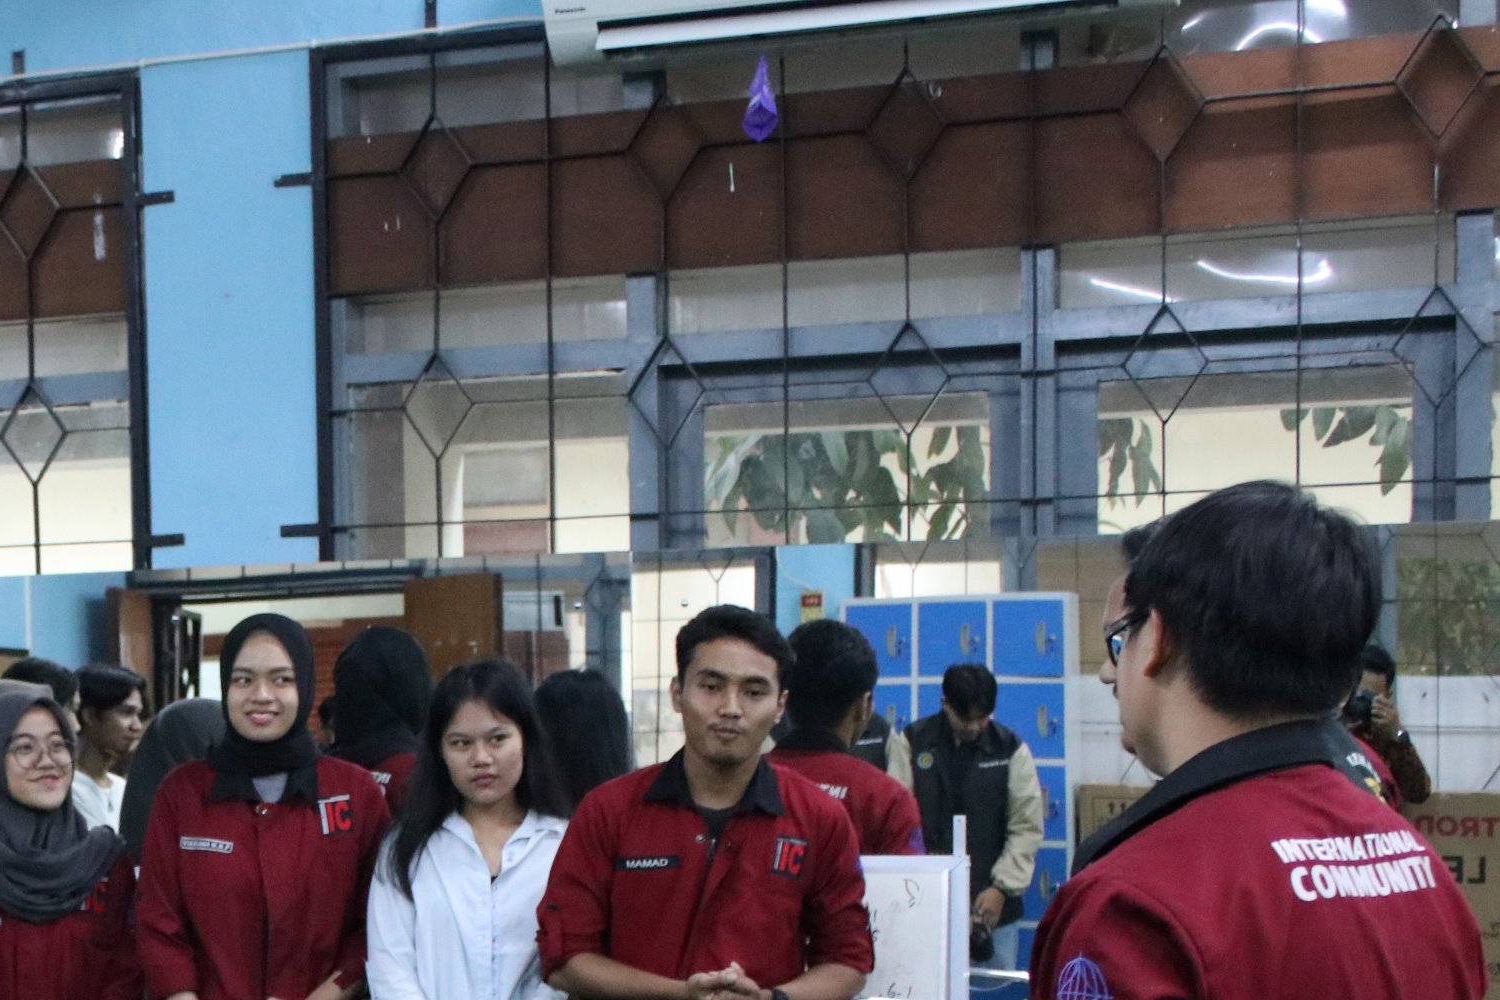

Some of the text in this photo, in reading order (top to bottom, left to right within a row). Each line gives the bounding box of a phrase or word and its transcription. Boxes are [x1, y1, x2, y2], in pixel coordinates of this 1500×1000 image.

[1271, 830, 1426, 863] INTERNATIONAL
[626, 858, 669, 869] MAMAD
[1290, 856, 1437, 902] COMMUNITY
